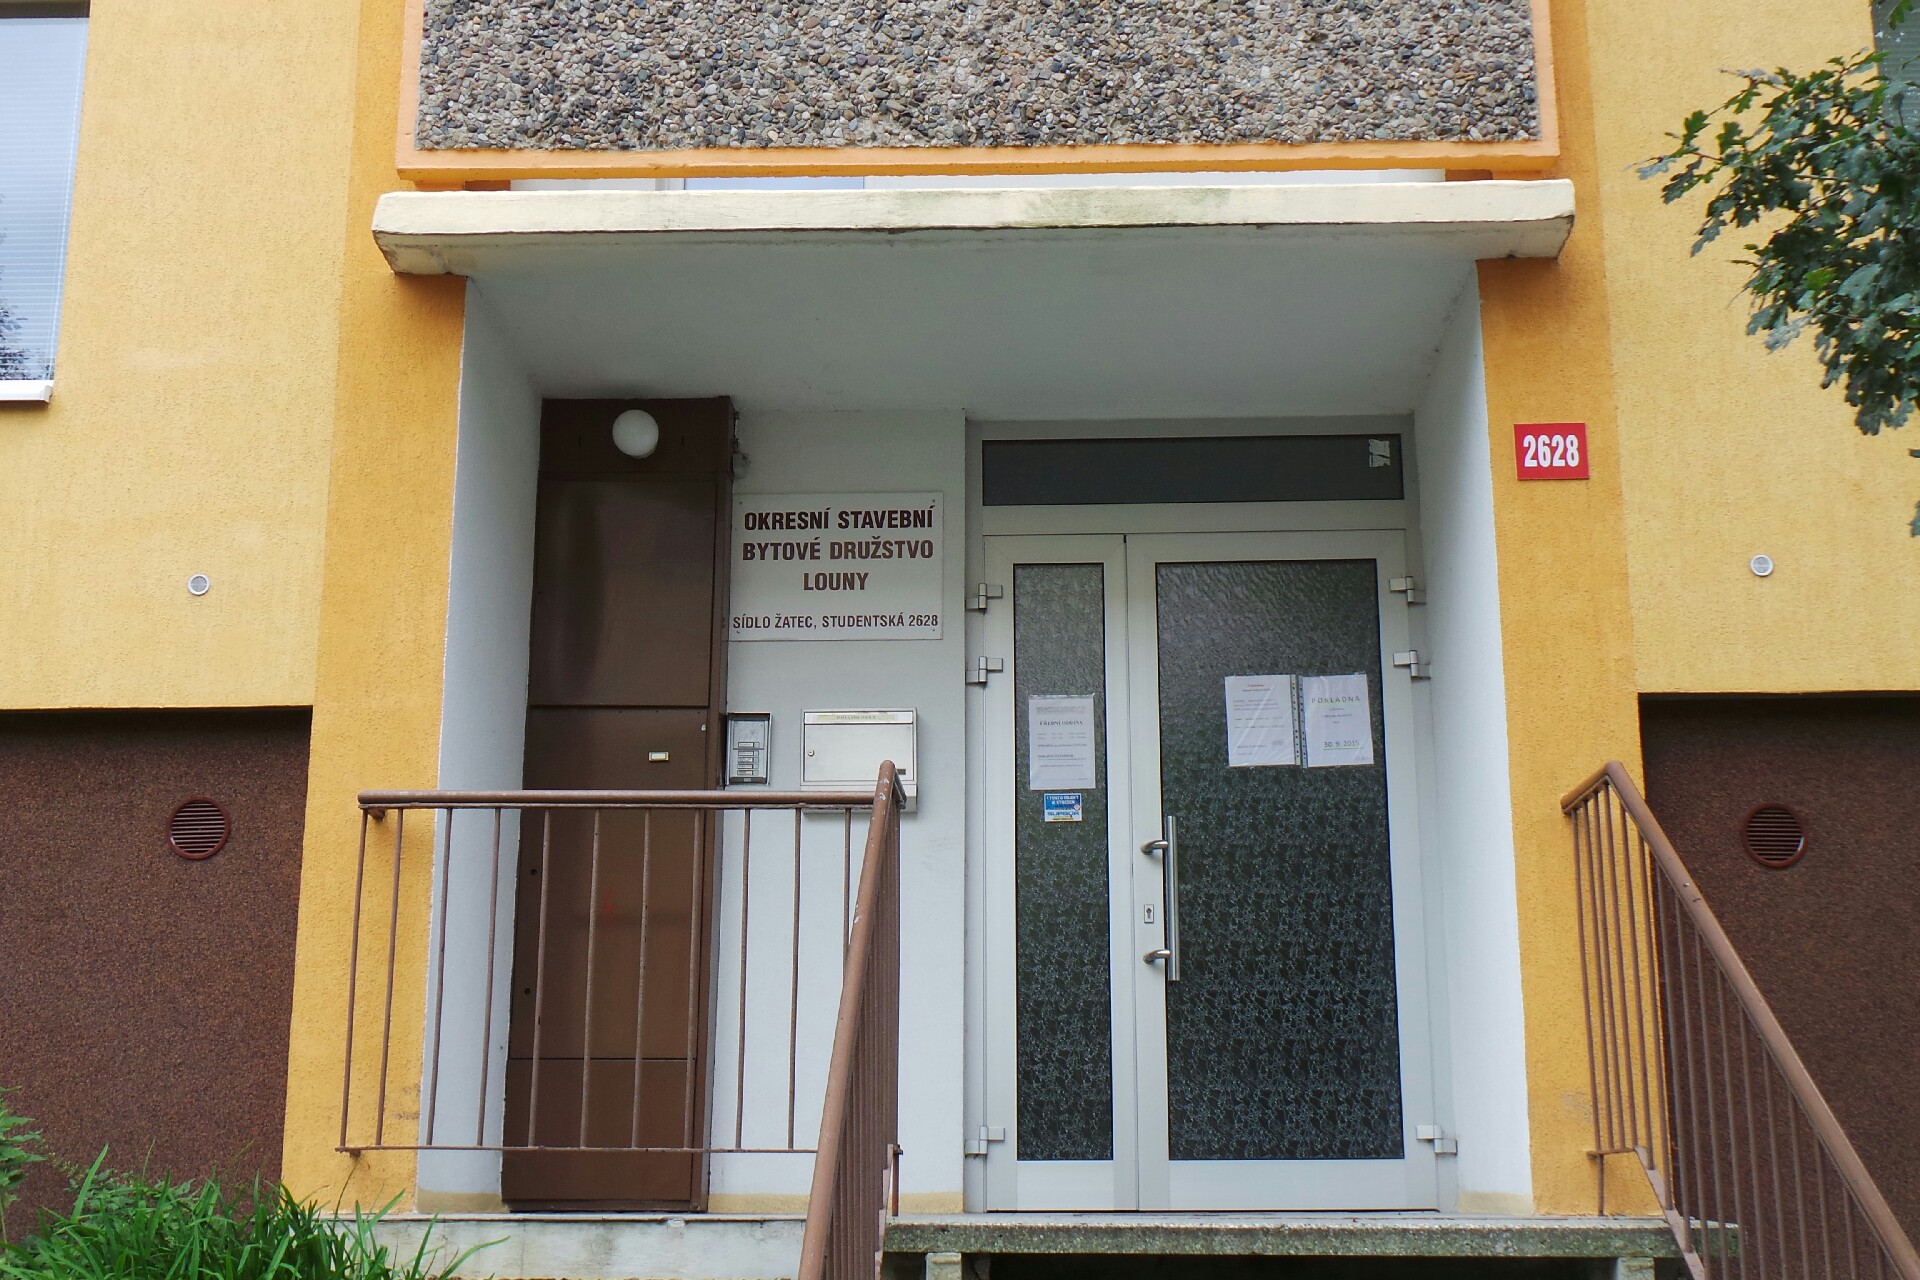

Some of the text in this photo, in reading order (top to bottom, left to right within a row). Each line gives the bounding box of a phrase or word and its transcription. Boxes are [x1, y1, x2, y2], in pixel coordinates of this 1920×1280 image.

[1523, 434, 1579, 467] 2628
[744, 505, 936, 530] OKRESNÍ STAVEBNÍ
[742, 536, 934, 561] BYTOVÉ DRUŽSTVO
[803, 573, 869, 591] LOUNY
[733, 612, 938, 630] SÍDLO ŽATEC, STUDENTSKÁ 2628
[1311, 695, 1361, 704] POKLADNA
